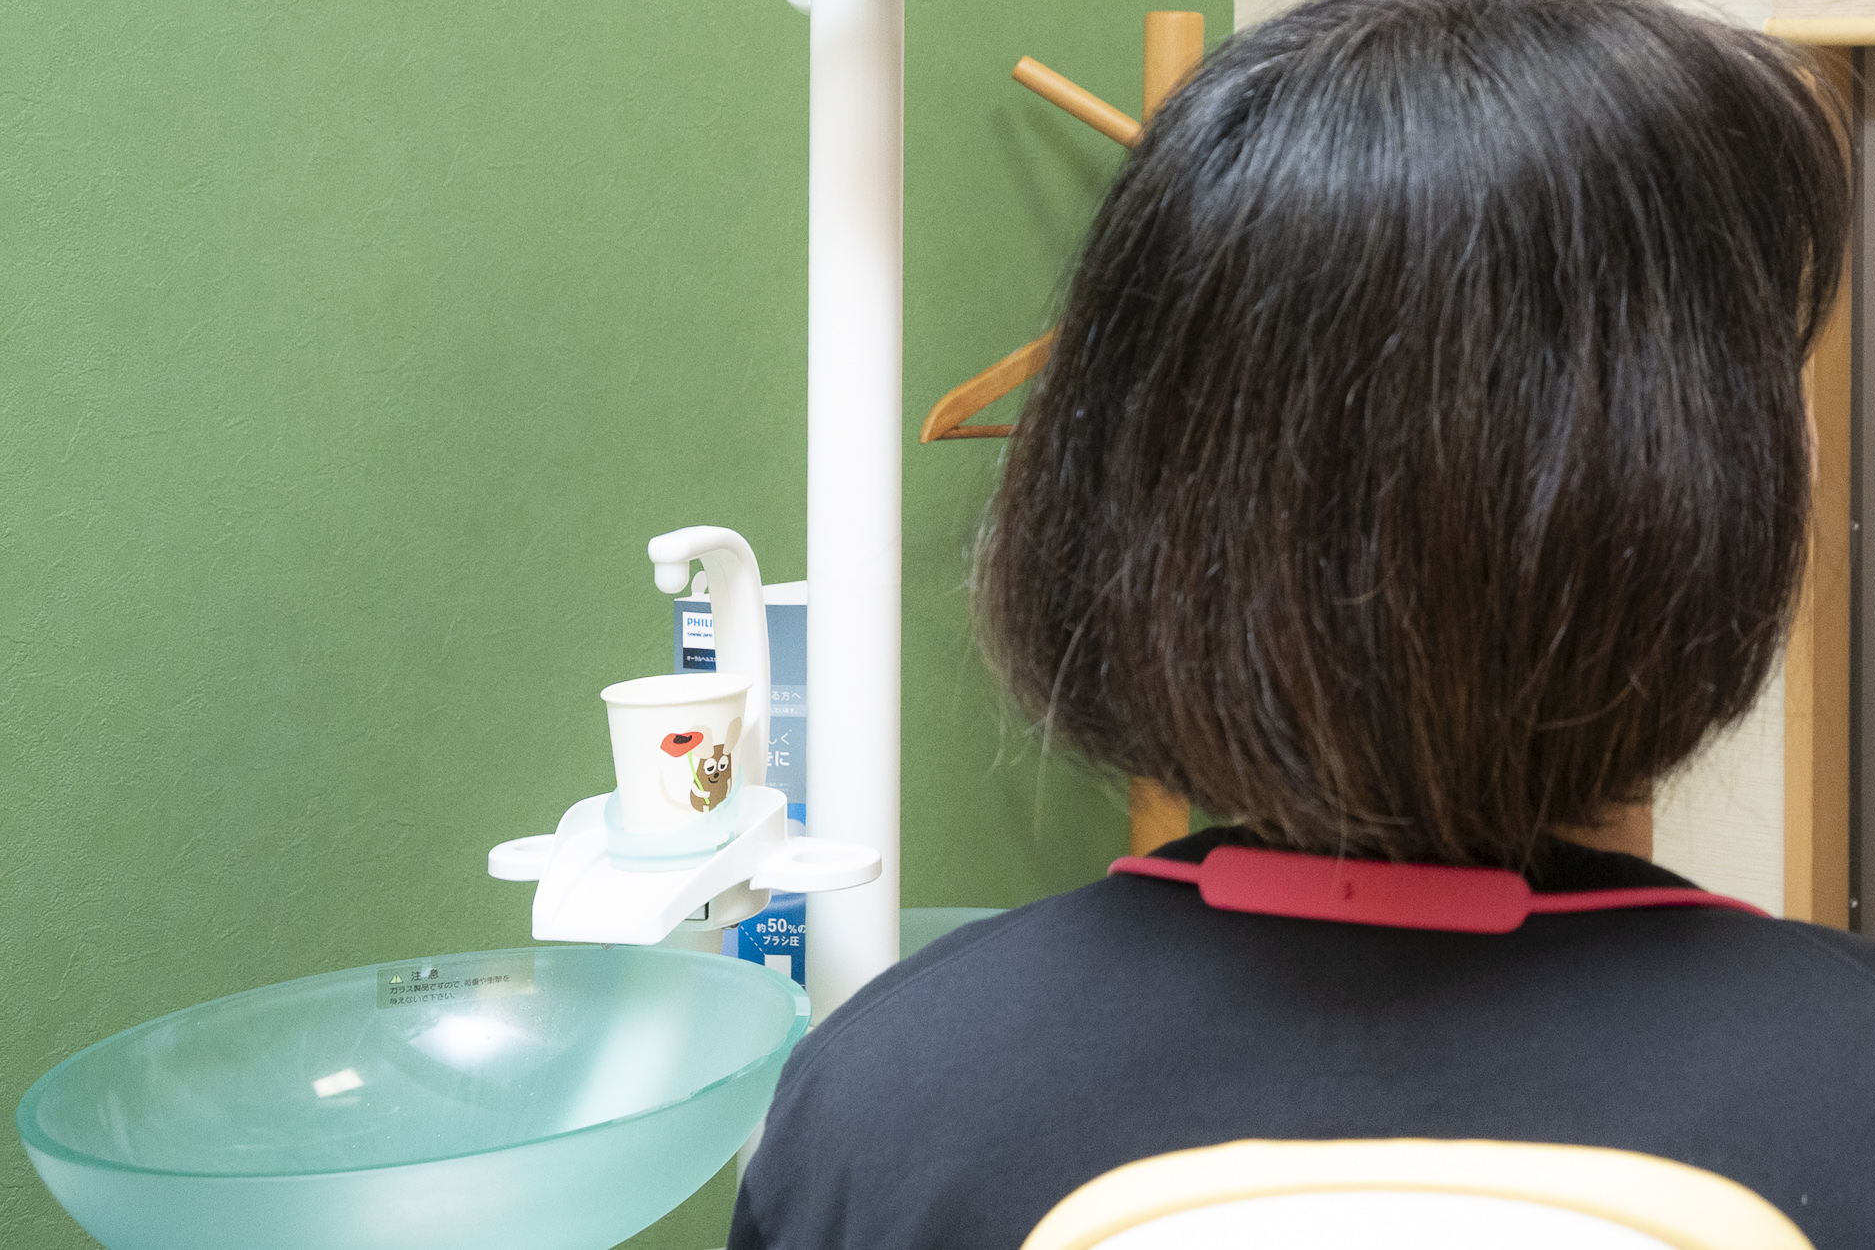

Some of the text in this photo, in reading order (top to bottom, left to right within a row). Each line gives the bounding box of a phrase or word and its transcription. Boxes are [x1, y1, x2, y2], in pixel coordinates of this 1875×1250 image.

[687, 617, 713, 628] PHILI
[686, 655, 716, 663] オーラルヘルス
[771, 690, 802, 701] る方へ
[763, 935, 800, 947] ブラシ圧
